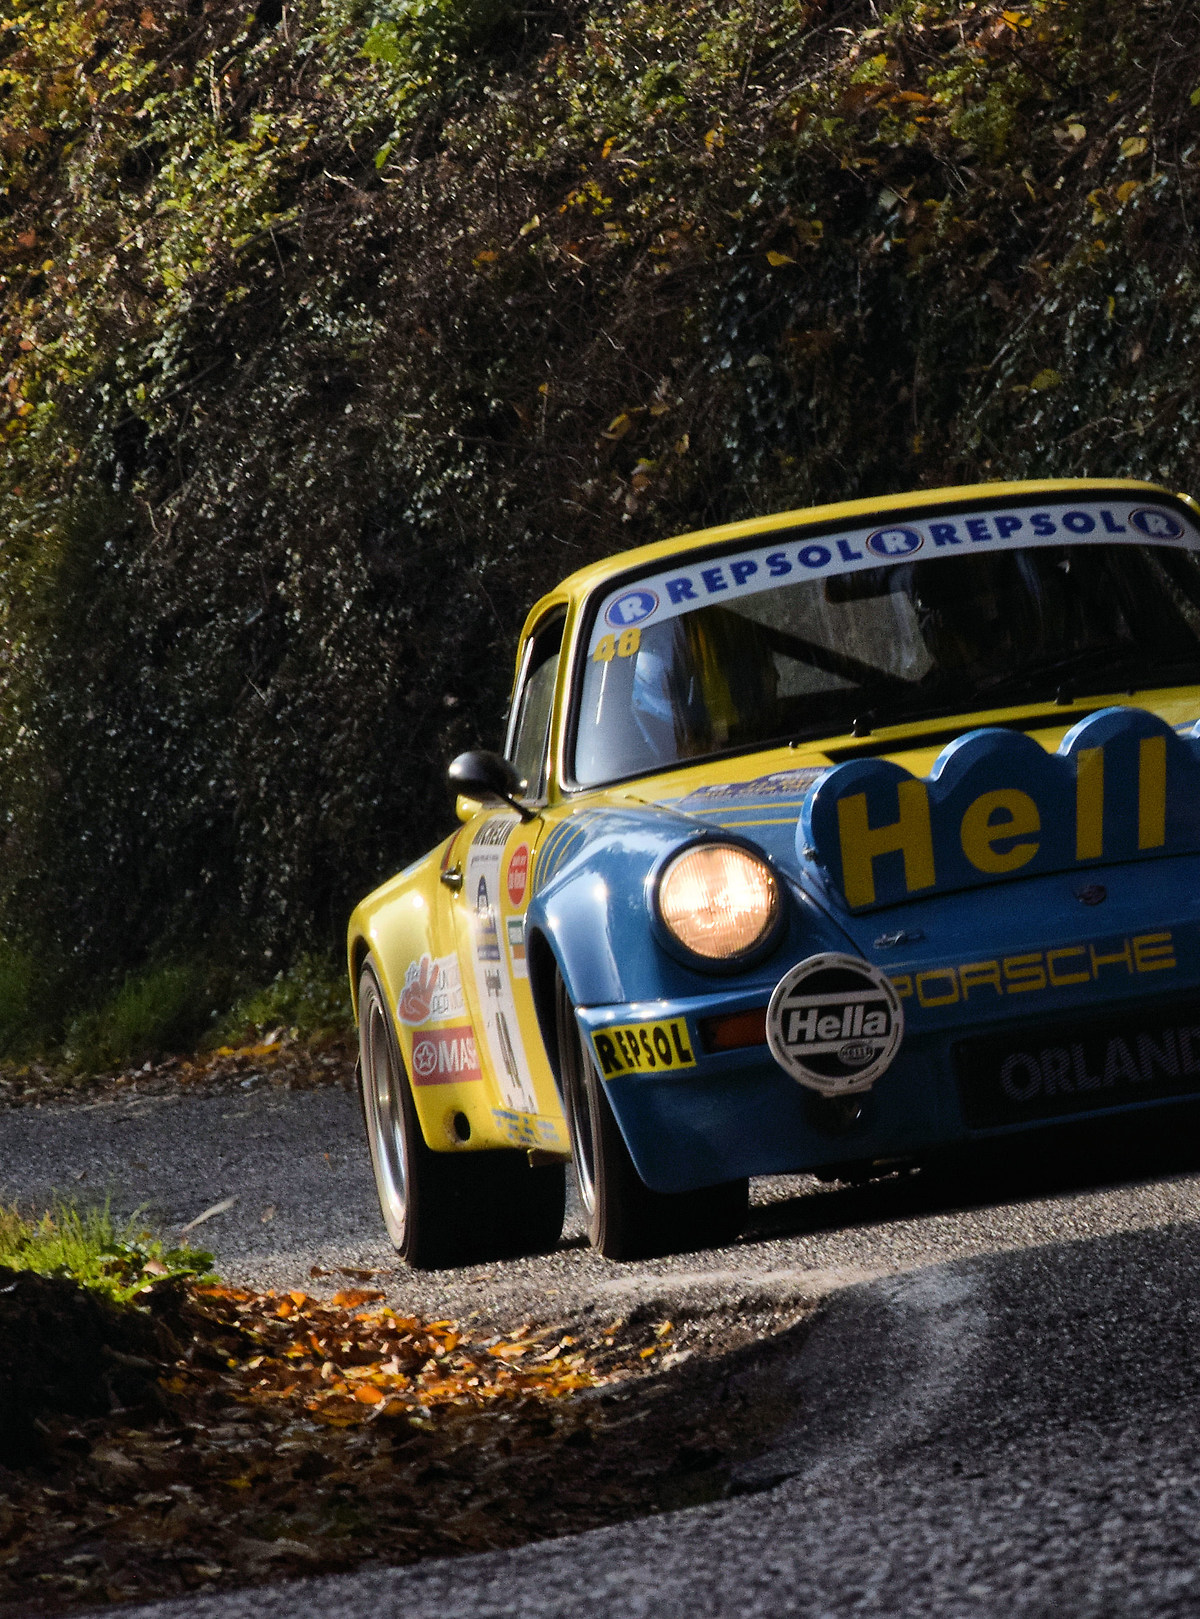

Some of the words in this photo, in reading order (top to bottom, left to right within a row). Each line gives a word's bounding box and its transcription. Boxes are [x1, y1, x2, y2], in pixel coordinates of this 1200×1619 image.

[665, 539, 863, 605] REPSOL
[928, 510, 1126, 547] REPSOL
[594, 1023, 693, 1074] REPSOL
[788, 1005, 888, 1043] Hella
